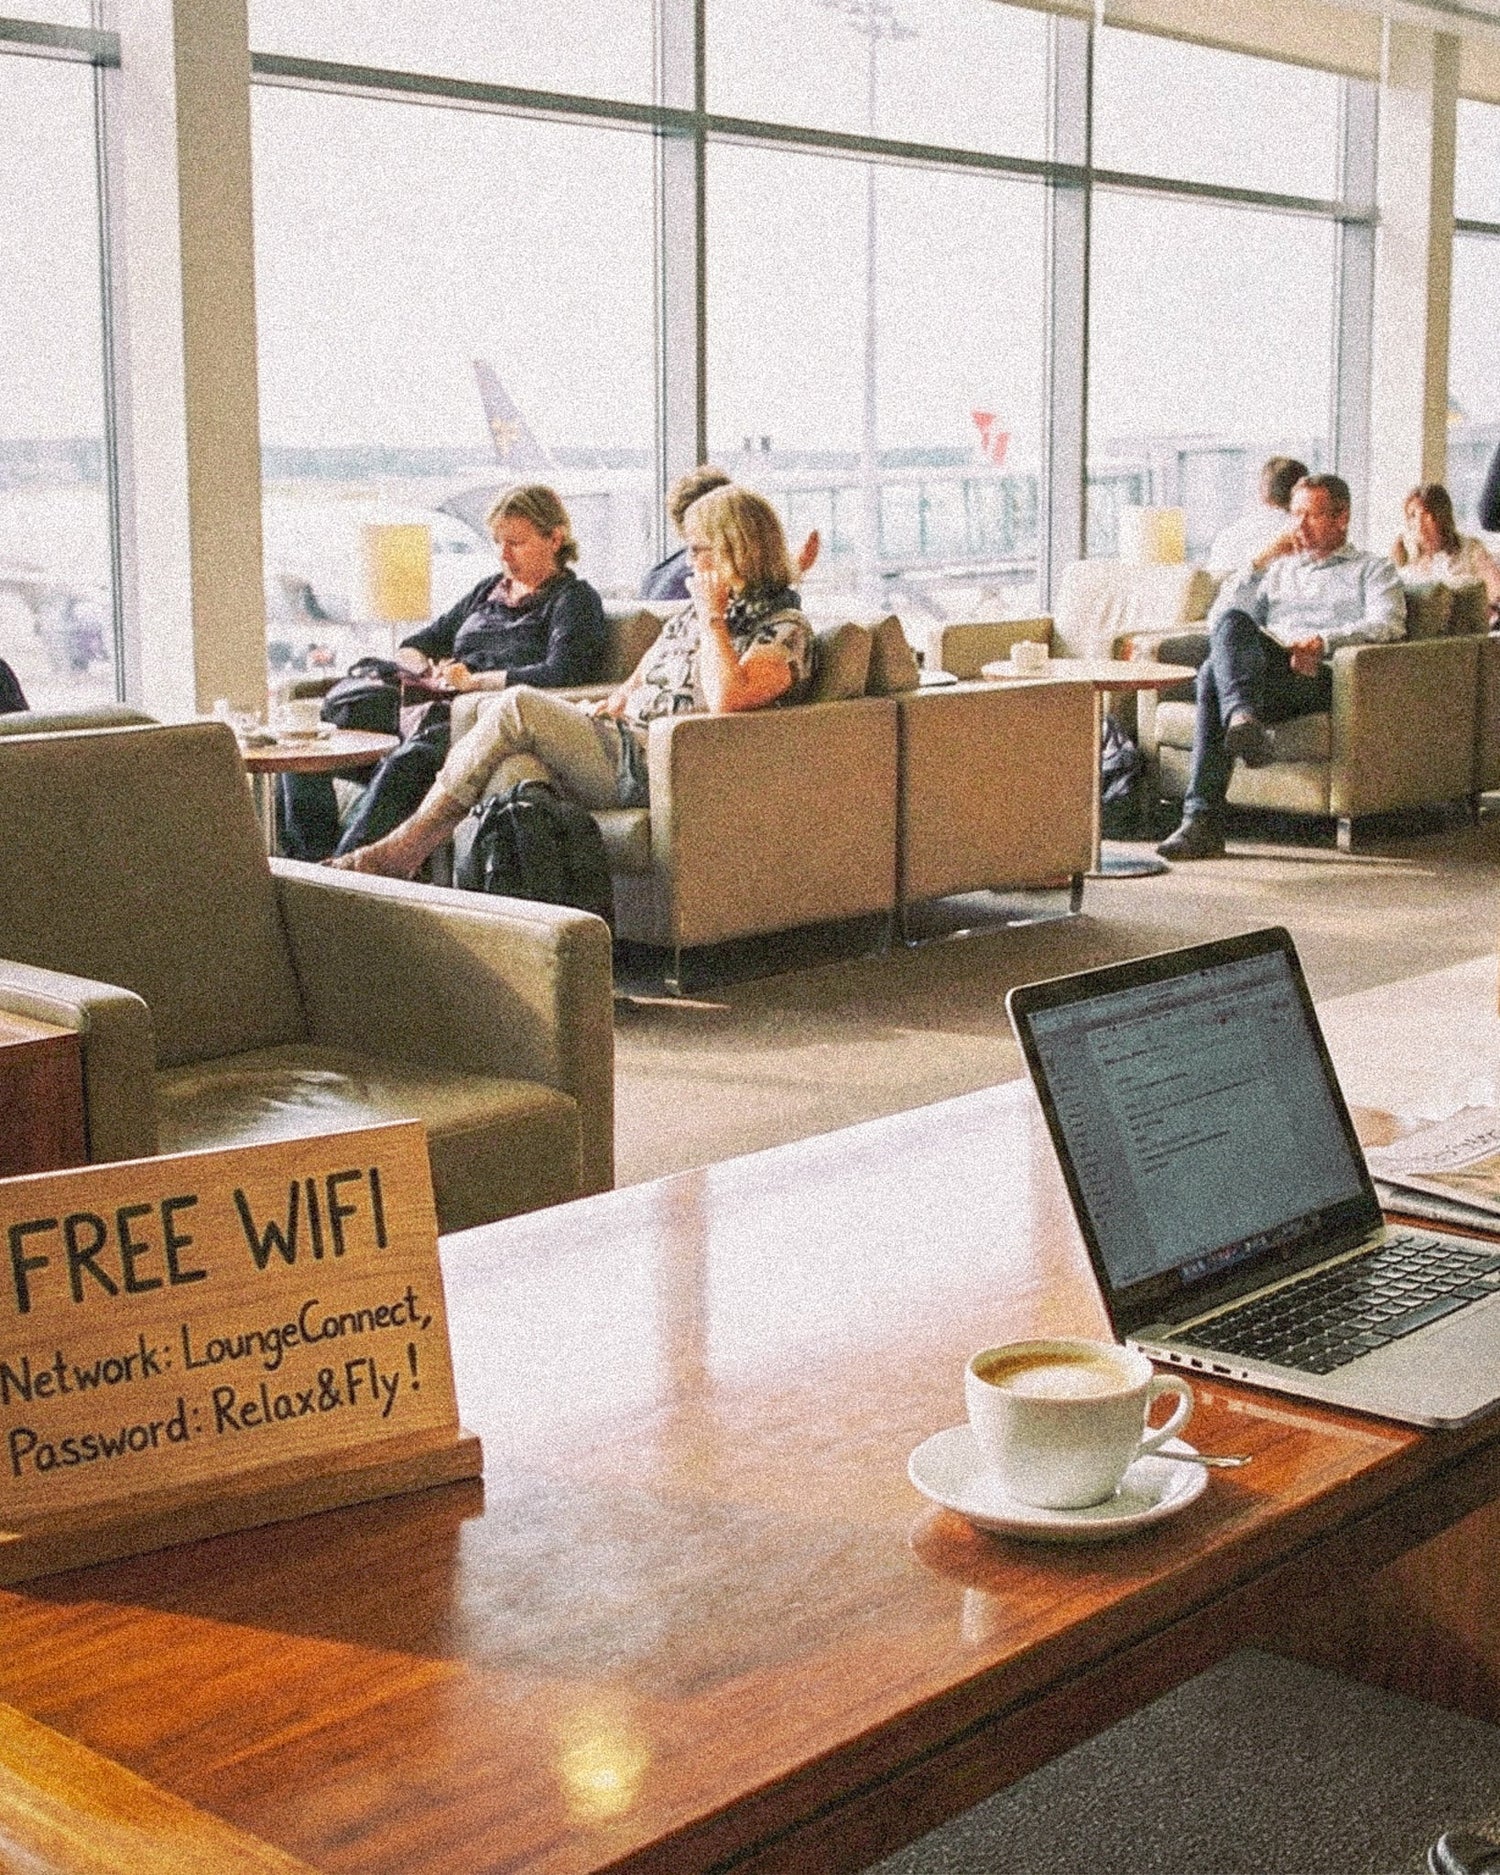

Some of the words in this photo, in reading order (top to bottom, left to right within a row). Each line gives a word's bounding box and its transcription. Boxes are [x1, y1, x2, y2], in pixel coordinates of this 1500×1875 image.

[9, 1196, 206, 1312] FREE
[235, 1168, 387, 1269] WIFI
[0, 1335, 172, 1402] Network:
[182, 1287, 431, 1370] LoungeConnect,
[8, 1399, 201, 1476] Password:
